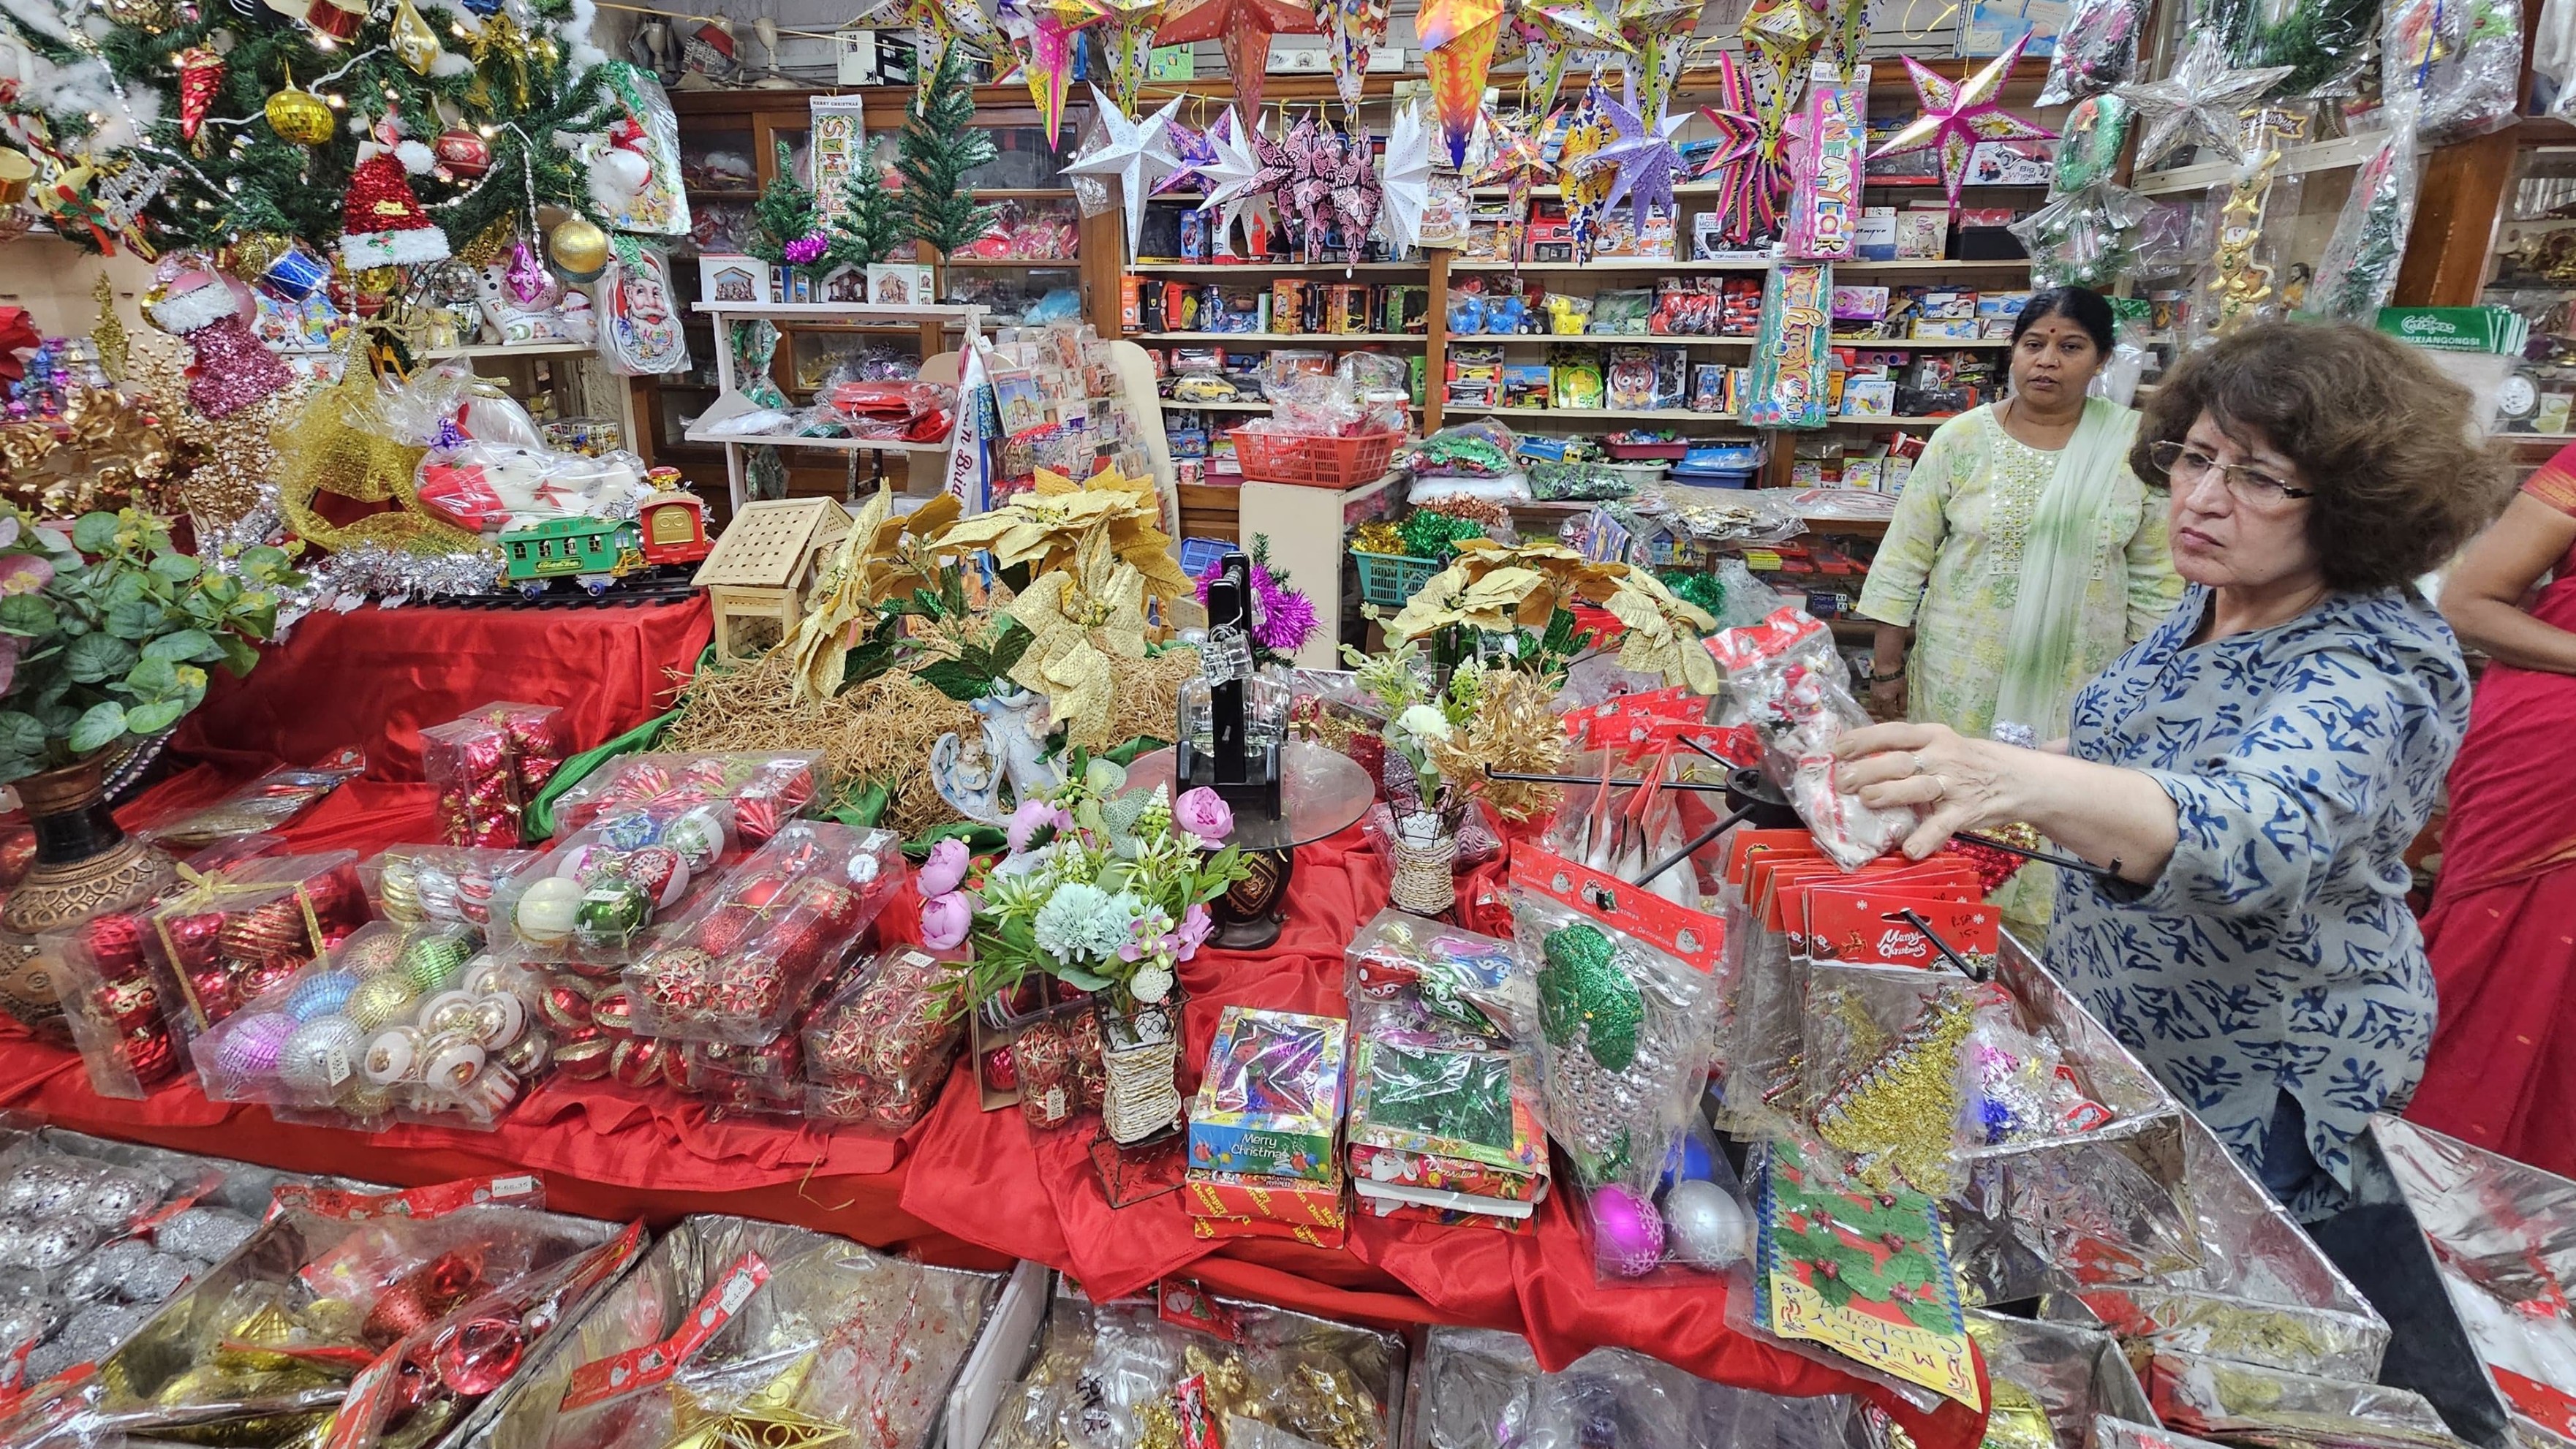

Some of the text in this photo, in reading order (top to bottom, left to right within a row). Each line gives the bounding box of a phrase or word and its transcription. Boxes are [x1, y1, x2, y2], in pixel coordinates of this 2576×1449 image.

[1839, 93, 1861, 127] HAPPY
[2008, 172, 2036, 180] Wheel
[2019, 165, 2036, 174] Big
[951, 448, 973, 499] Brid
[1636, 925, 1674, 948] Decorations
[1879, 942, 1927, 958] Christmas
[1240, 1133, 1277, 1150] Merry
[1191, 1181, 1223, 1218] Decoreti
[1204, 1185, 1228, 1215] Happy
[725, 1280, 749, 1309] R-4-59
